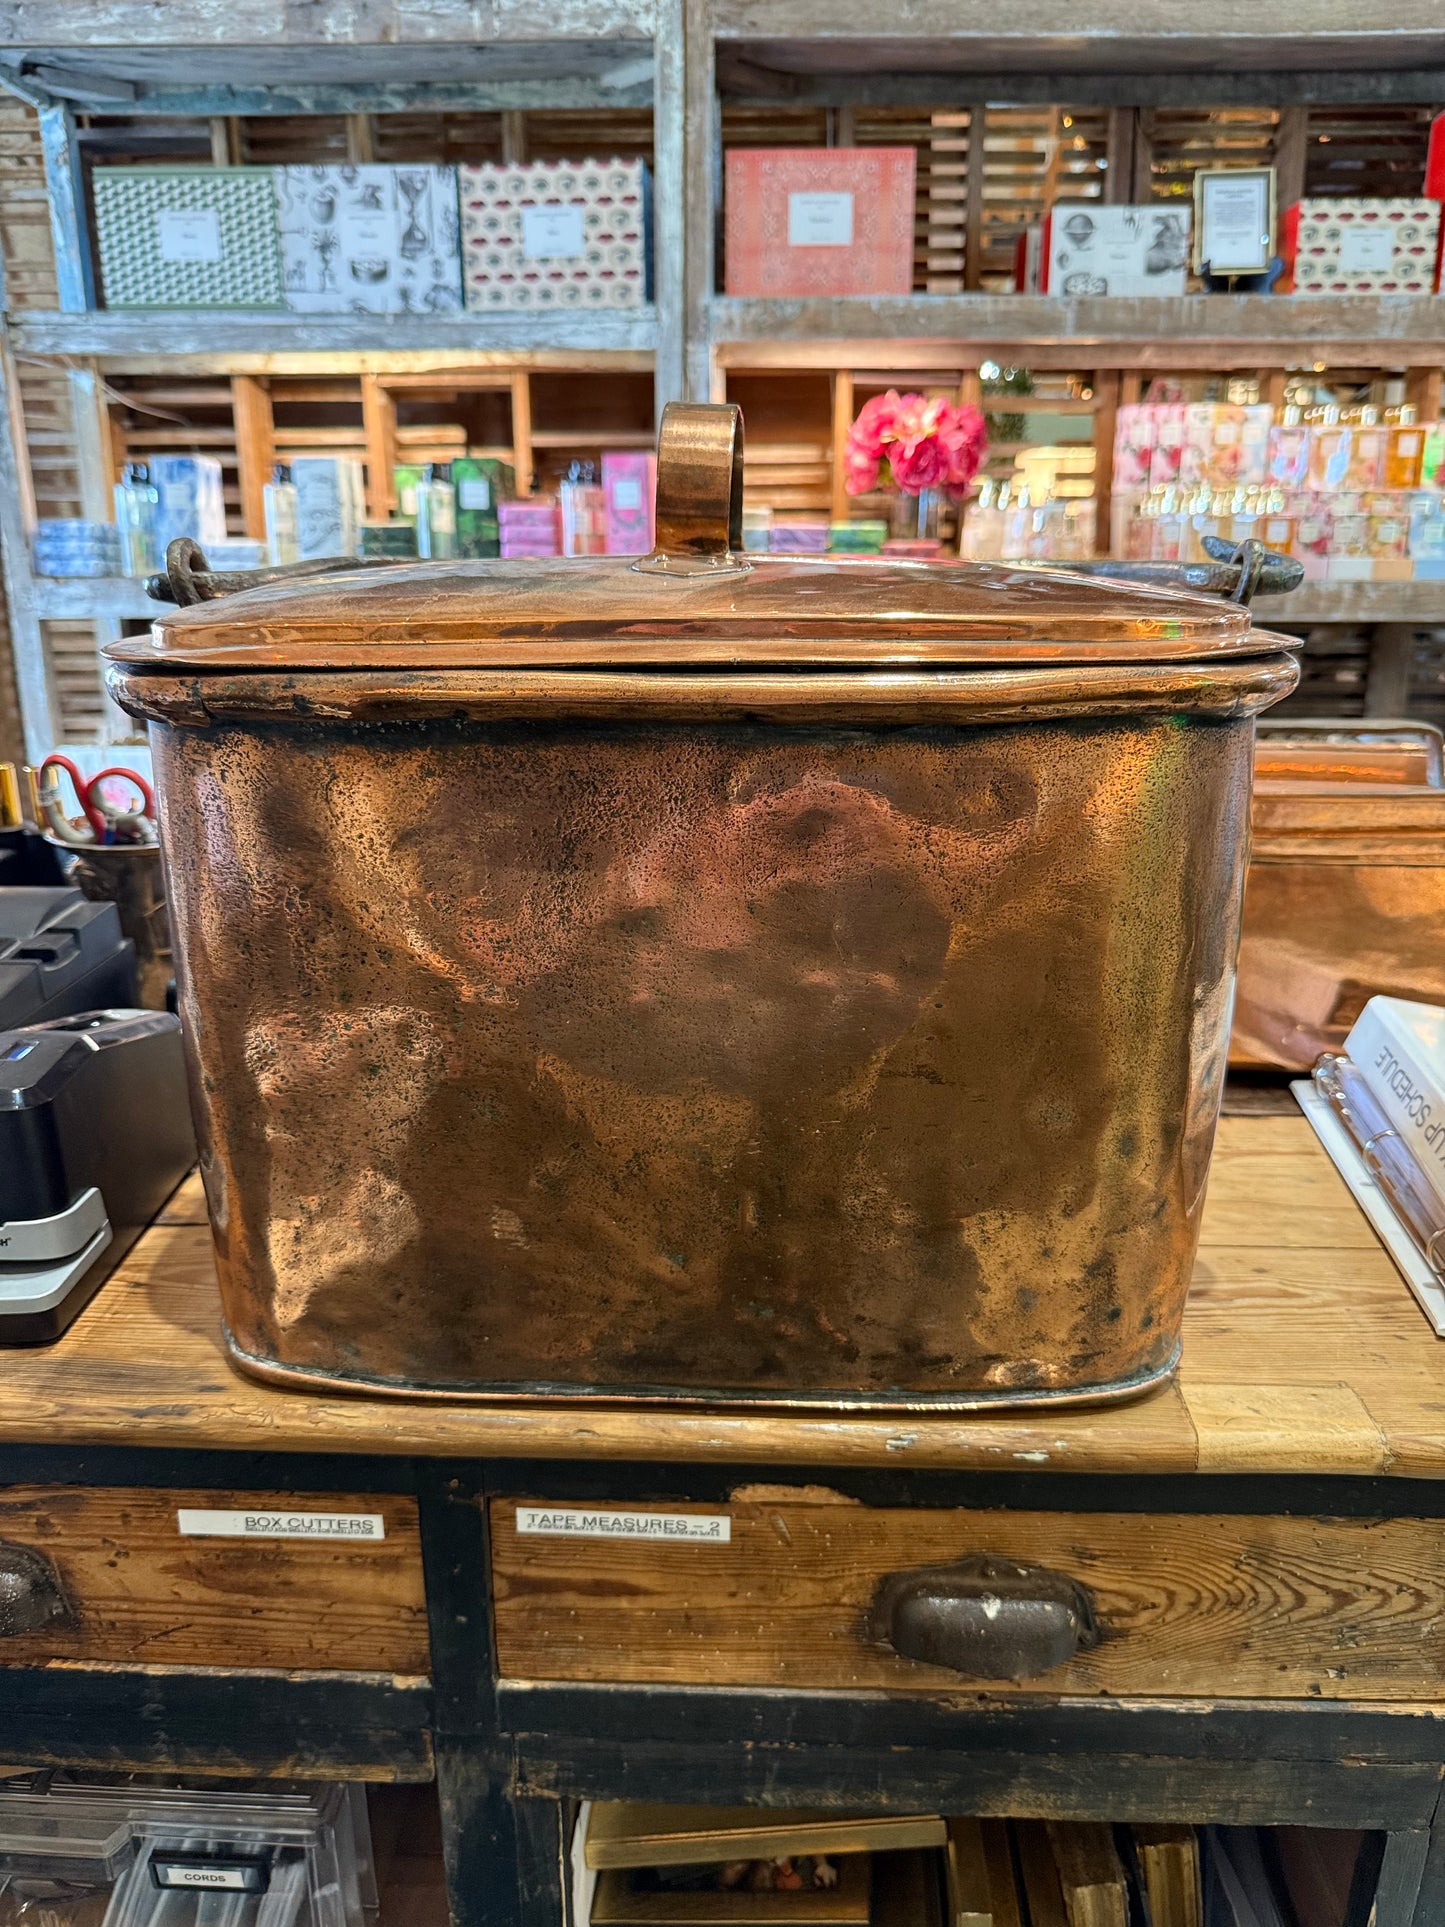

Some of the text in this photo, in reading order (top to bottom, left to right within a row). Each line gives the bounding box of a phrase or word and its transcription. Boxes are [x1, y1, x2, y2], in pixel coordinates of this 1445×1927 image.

[1374, 1045, 1431, 1128] SCHEDULE
[245, 1516, 374, 1530] BOX CUTTERS
[527, 1513, 577, 1526] TAPE
[582, 1515, 688, 1530] MEASURES
[709, 1520, 720, 1531] 2
[184, 1873, 226, 1882] CORDS
